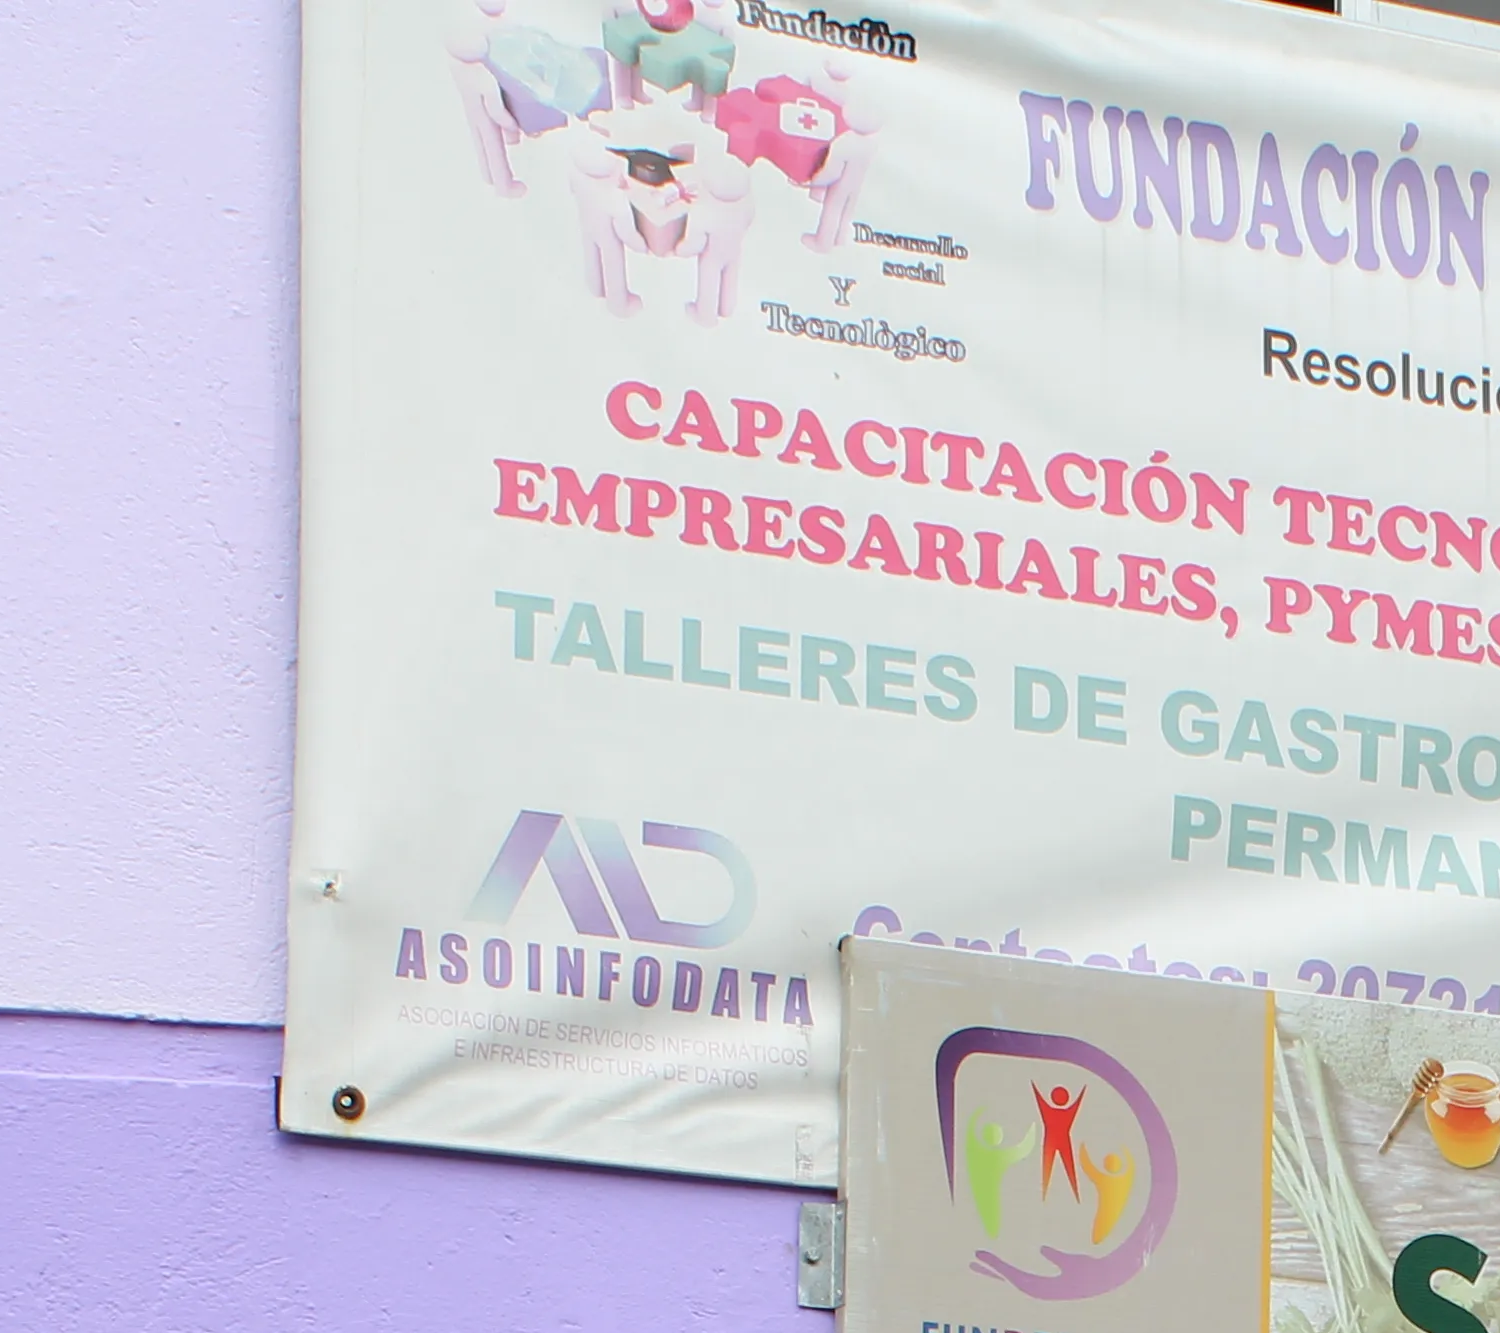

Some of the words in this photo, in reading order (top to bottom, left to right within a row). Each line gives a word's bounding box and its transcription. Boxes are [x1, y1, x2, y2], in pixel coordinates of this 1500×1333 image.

[1019, 91, 1490, 292] FUNDACIÓN
[853, 221, 969, 262] Desarrollo
[883, 260, 945, 285] social
[830, 277, 855, 305] Y
[605, 380, 1250, 534] CAPACITACIÓN
[493, 458, 1241, 641] EMPRESARIALES,
[493, 591, 978, 723] TALLERES
[1012, 666, 1128, 745] DE
[395, 927, 815, 1027] ASOINFODATA
[397, 1003, 520, 1039] ASOCIACIÓN
[525, 1016, 550, 1041] DE
[555, 1019, 656, 1053] SERVICIOS
[662, 1031, 808, 1068] INFORMÁTICOS
[454, 1040, 467, 1058] E
[472, 1042, 658, 1083] INFRAESTRUCTURA
[662, 1064, 688, 1085] DE
[694, 1067, 759, 1090] DATOS
